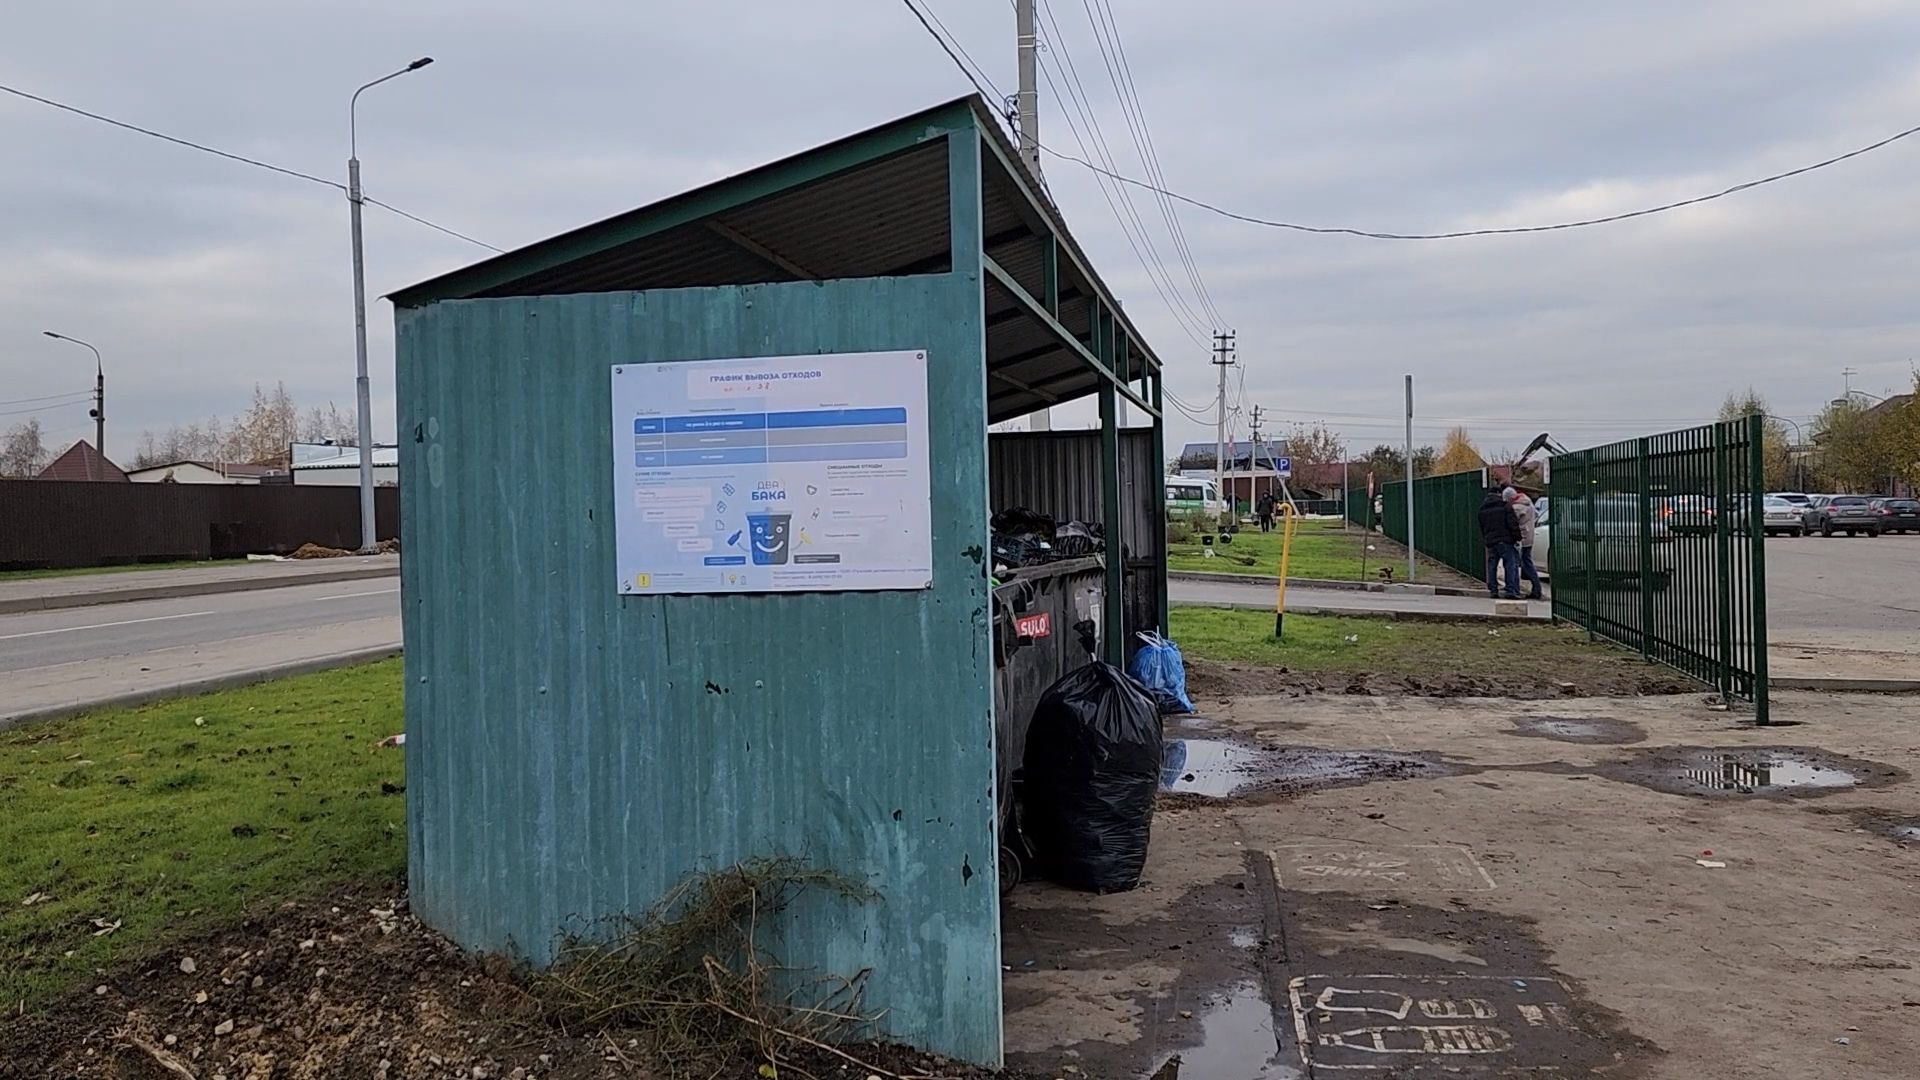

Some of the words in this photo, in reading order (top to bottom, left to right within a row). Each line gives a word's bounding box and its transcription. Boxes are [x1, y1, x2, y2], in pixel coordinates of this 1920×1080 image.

[710, 374, 743, 383] ГРАФИК
[745, 372, 780, 381] ВЫВОЗА
[782, 371, 822, 380] ОТХОДОВ
[1280, 458, 1289, 470] P
[757, 480, 779, 490] ДВА
[751, 490, 786, 501] БАКА
[1020, 617, 1046, 636] SULO
